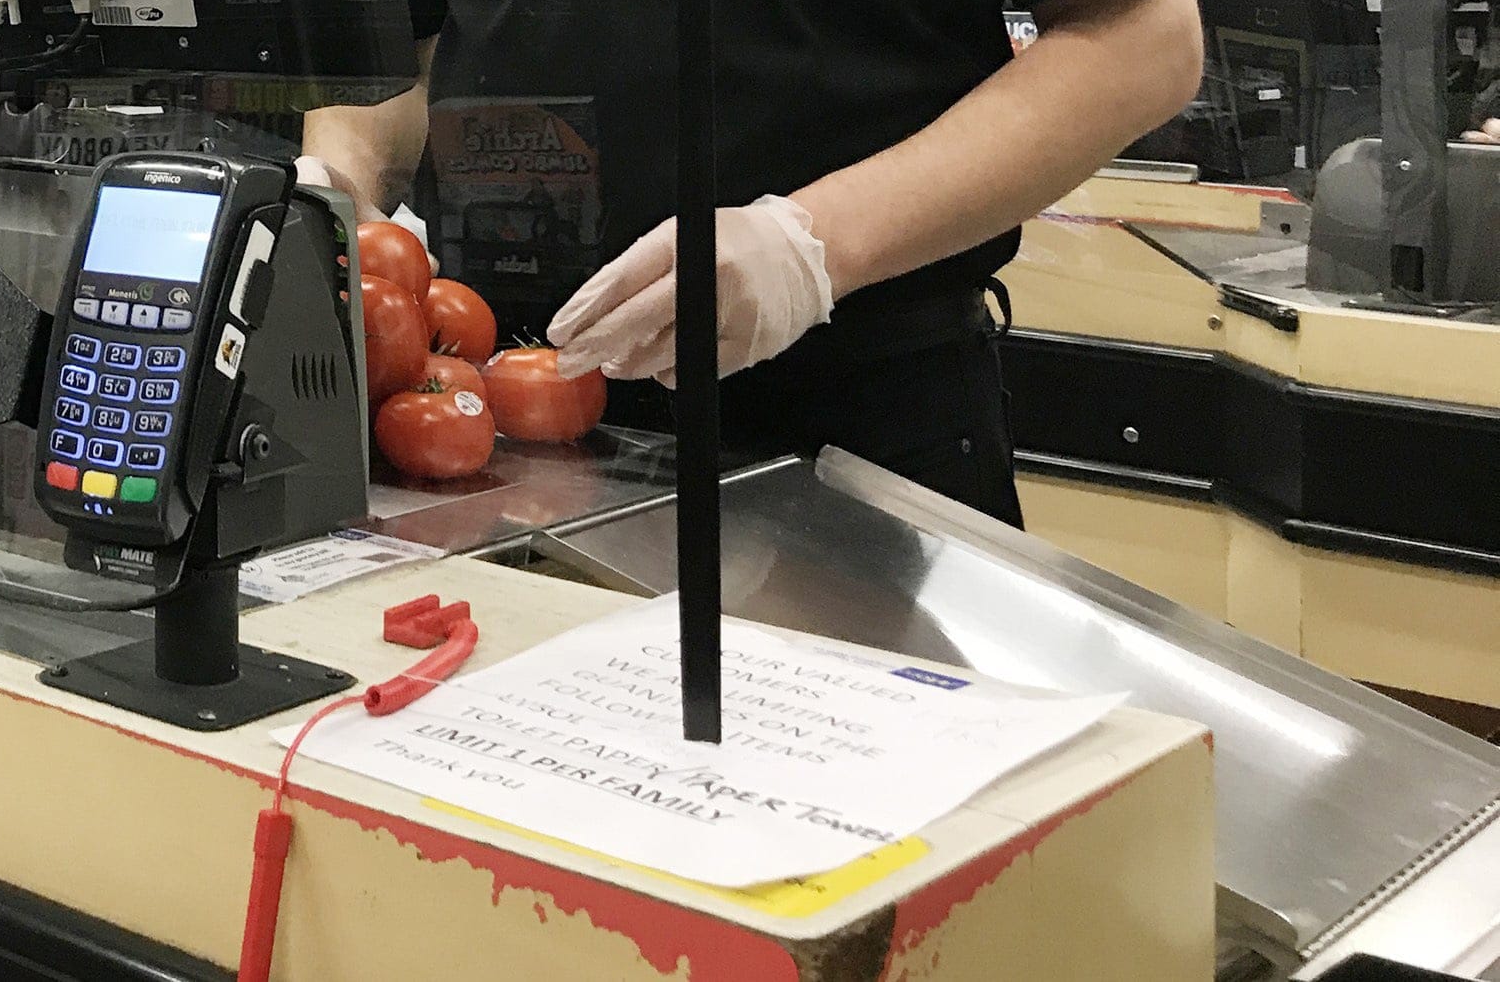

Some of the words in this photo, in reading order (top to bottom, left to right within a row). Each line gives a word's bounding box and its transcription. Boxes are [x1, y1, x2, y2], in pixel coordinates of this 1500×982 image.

[144, 171, 182, 185] ingenico
[73, 339, 80, 354] 1
[110, 347, 119, 362] 2
[152, 350, 162, 365] 3
[66, 371, 74, 385] 4
[104, 379, 113, 394] 5
[145, 383, 154, 398] 6
[61, 402, 69, 417] 7
[99, 411, 108, 426] 8
[139, 415, 149, 430] 9
[55, 435, 65, 449] F
[92, 443, 103, 458] 0
[641, 645, 828, 699] CUOMERS
[794, 665, 917, 704] VALUED
[606, 657, 657, 679] WE
[722, 689, 872, 735] LIMITING
[497, 693, 587, 725] LYSOL
[459, 705, 561, 740] TOILET
[726, 730, 830, 764] ITEMS
[758, 719, 813, 738] ON
[820, 736, 887, 760] THE
[372, 737, 462, 772] Thank
[463, 767, 527, 790] you
[415, 723, 506, 754] LIMIT
[503, 748, 527, 761] 1
[530, 756, 597, 781] PER
[598, 775, 736, 821] FAMILY
